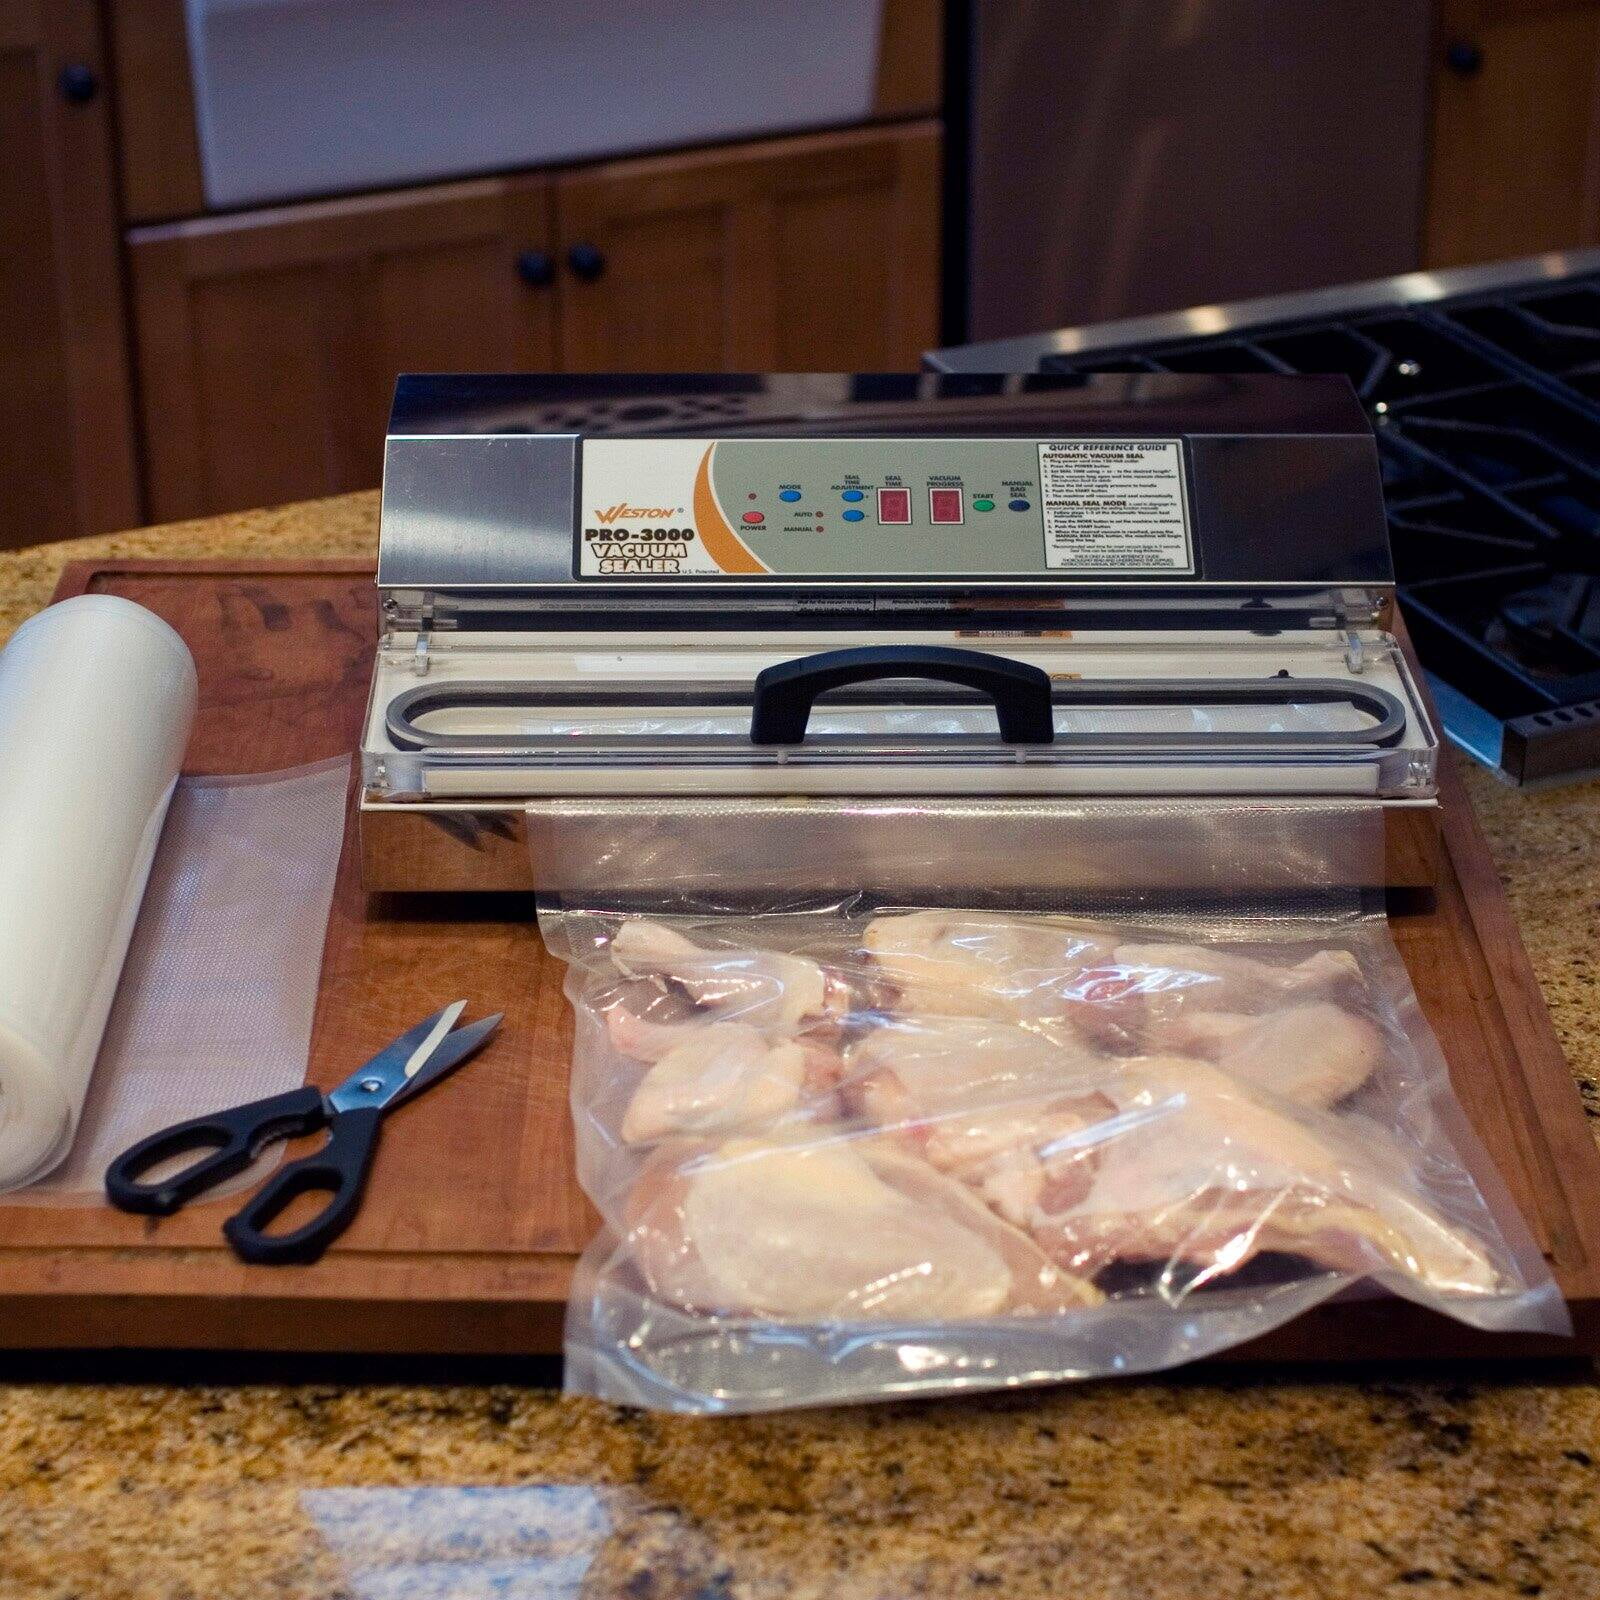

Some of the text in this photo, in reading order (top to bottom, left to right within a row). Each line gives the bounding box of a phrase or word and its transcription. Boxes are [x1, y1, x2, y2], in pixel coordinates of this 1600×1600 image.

[594, 503, 675, 524] WESTON
[585, 528, 694, 541] PRO-3000
[591, 543, 688, 558] VACUUM
[599, 559, 680, 574] SEALER
